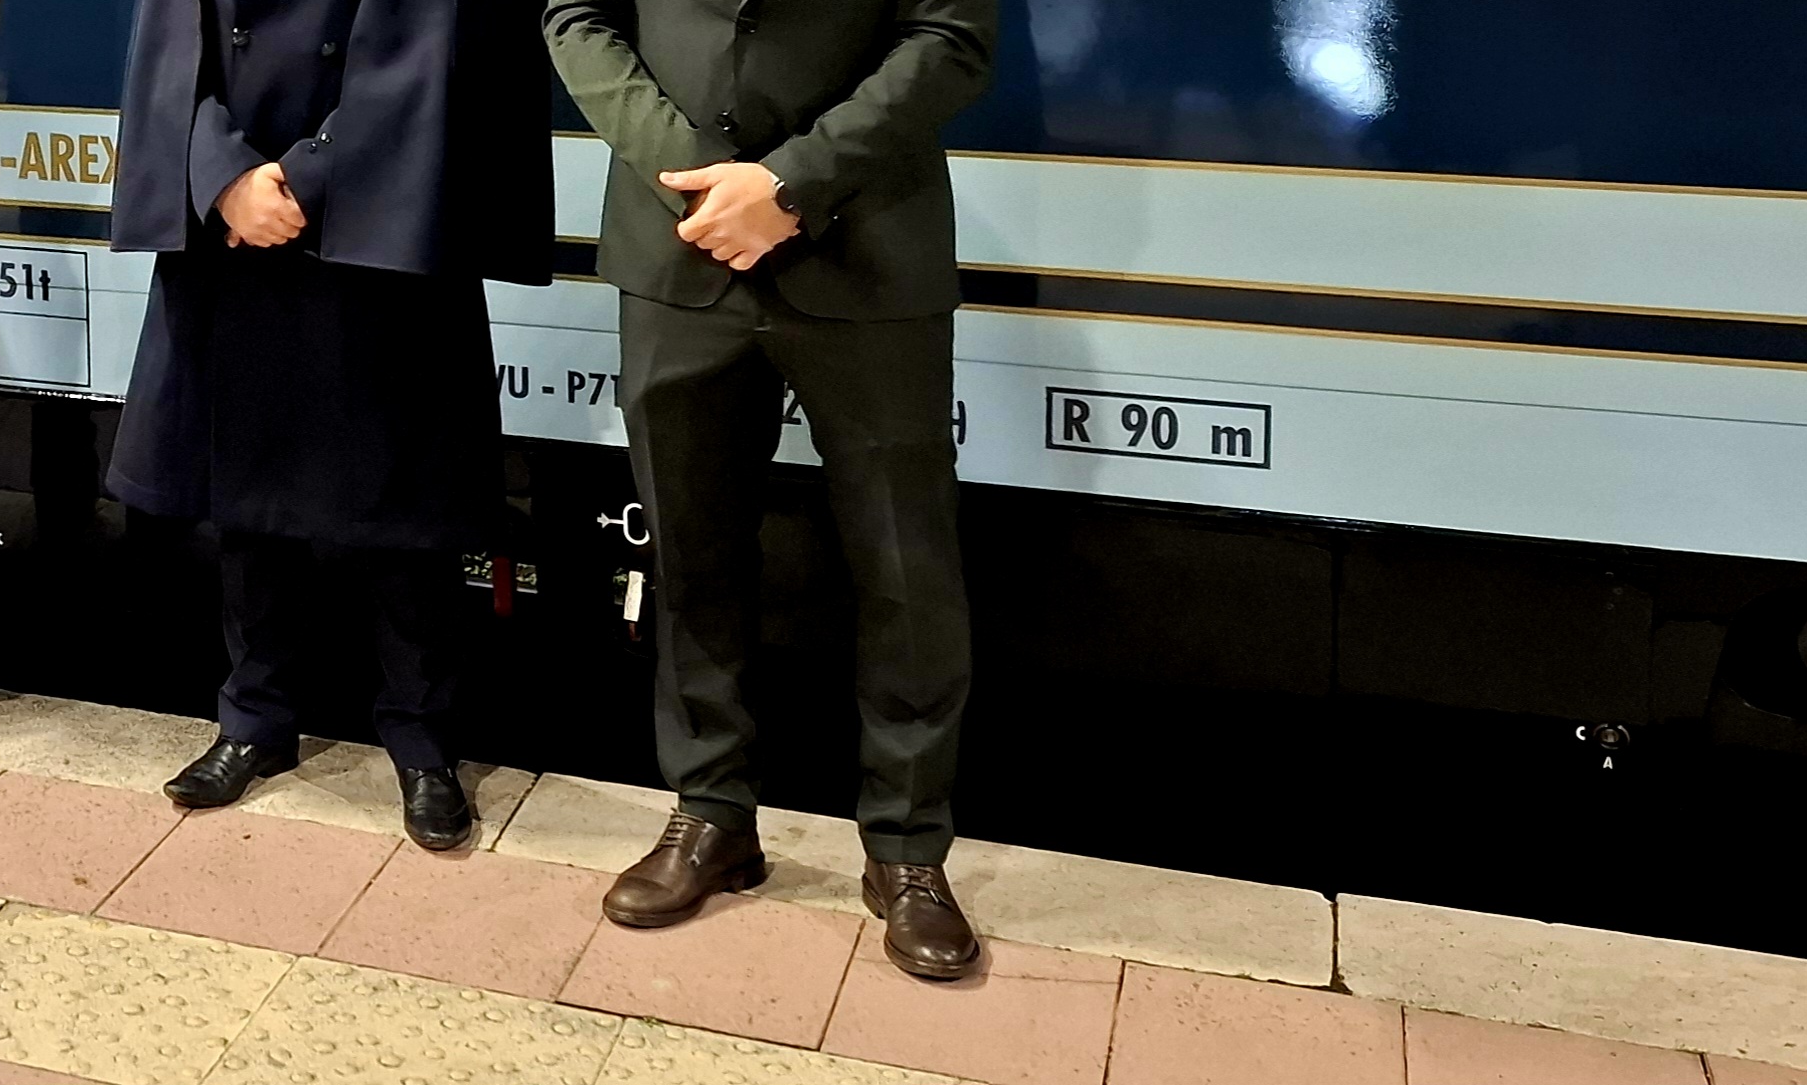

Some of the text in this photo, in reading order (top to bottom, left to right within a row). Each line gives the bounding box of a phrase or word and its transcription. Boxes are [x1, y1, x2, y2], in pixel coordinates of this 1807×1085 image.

[0, 261, 51, 302] 51t
[1062, 398, 1253, 458] R 90 m
